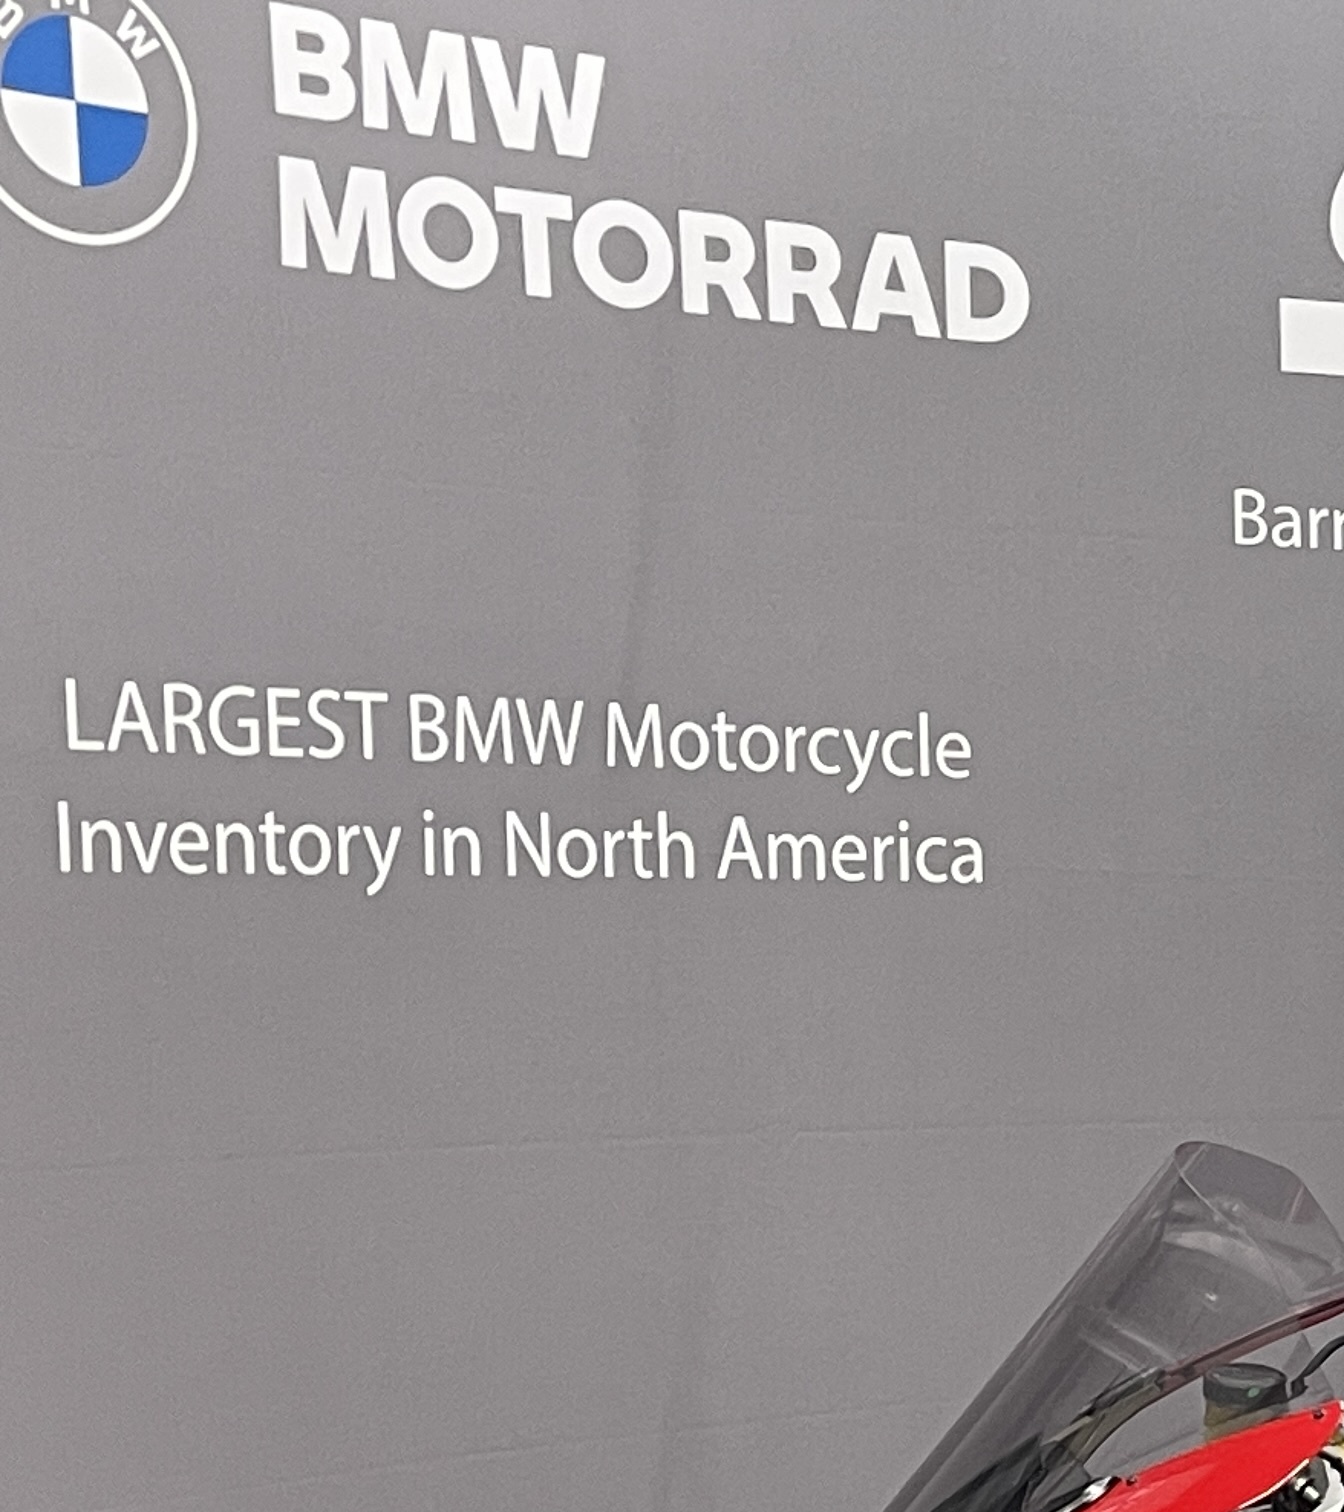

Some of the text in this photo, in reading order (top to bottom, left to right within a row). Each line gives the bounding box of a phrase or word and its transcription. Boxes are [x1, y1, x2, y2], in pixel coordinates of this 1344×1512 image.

[268, 1, 606, 159] BMW
[278, 155, 1030, 343] MOTORRAD
[65, 677, 972, 794] LARGEST BMW Motorcycle
[57, 800, 984, 896] Inventory in North America
